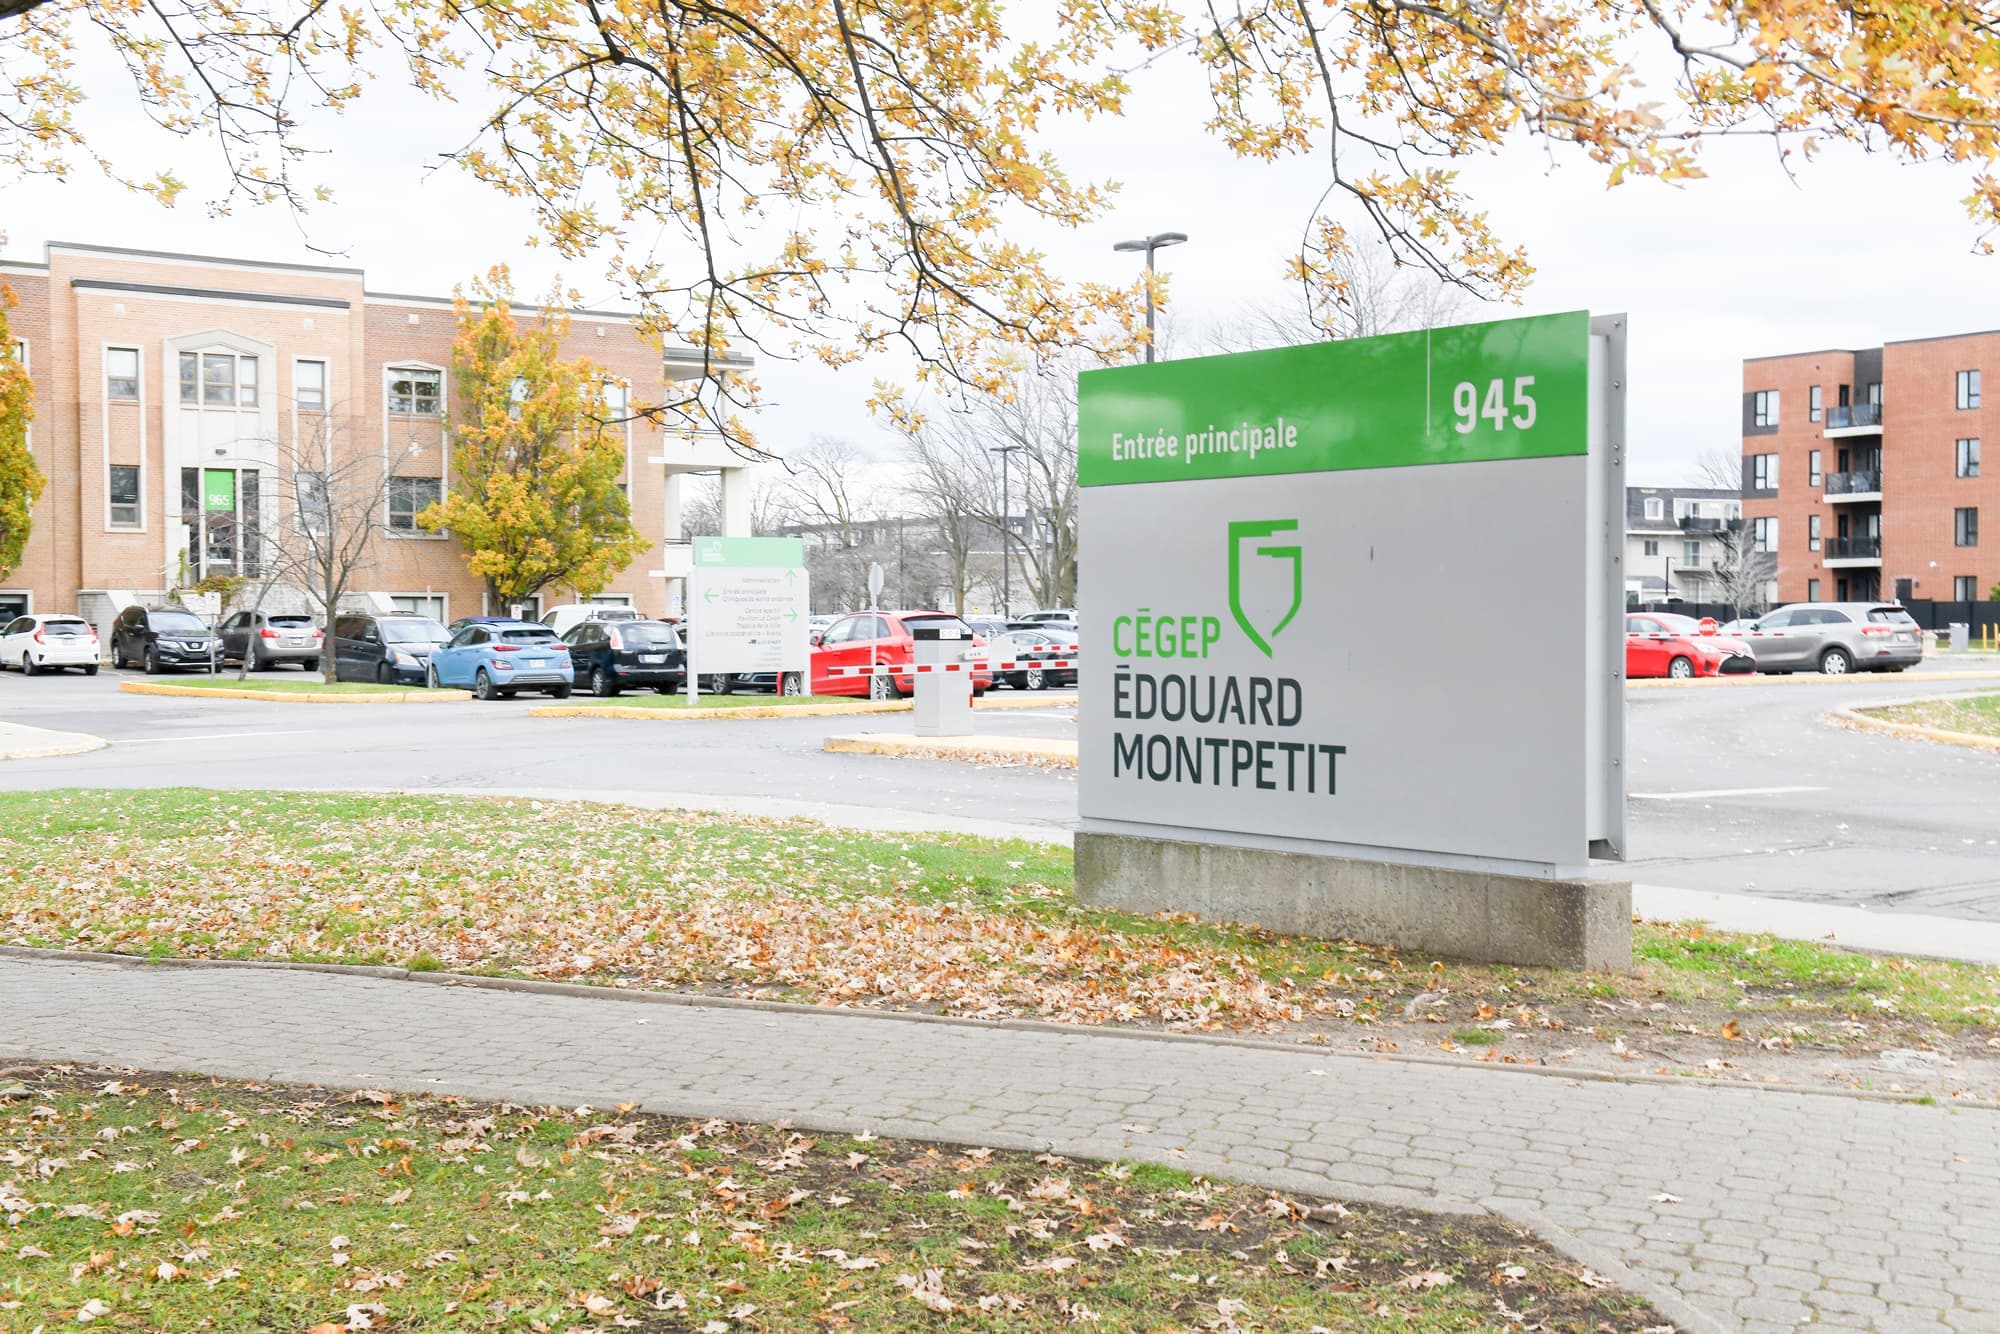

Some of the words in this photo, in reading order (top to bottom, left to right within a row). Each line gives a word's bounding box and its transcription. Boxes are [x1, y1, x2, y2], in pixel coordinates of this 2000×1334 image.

[1453, 375, 1537, 434] 945
[1112, 428, 1178, 461] Entrée
[1185, 417, 1297, 464] principale
[209, 494, 230, 506] 965
[1114, 732, 1347, 796] MONTPETIT
